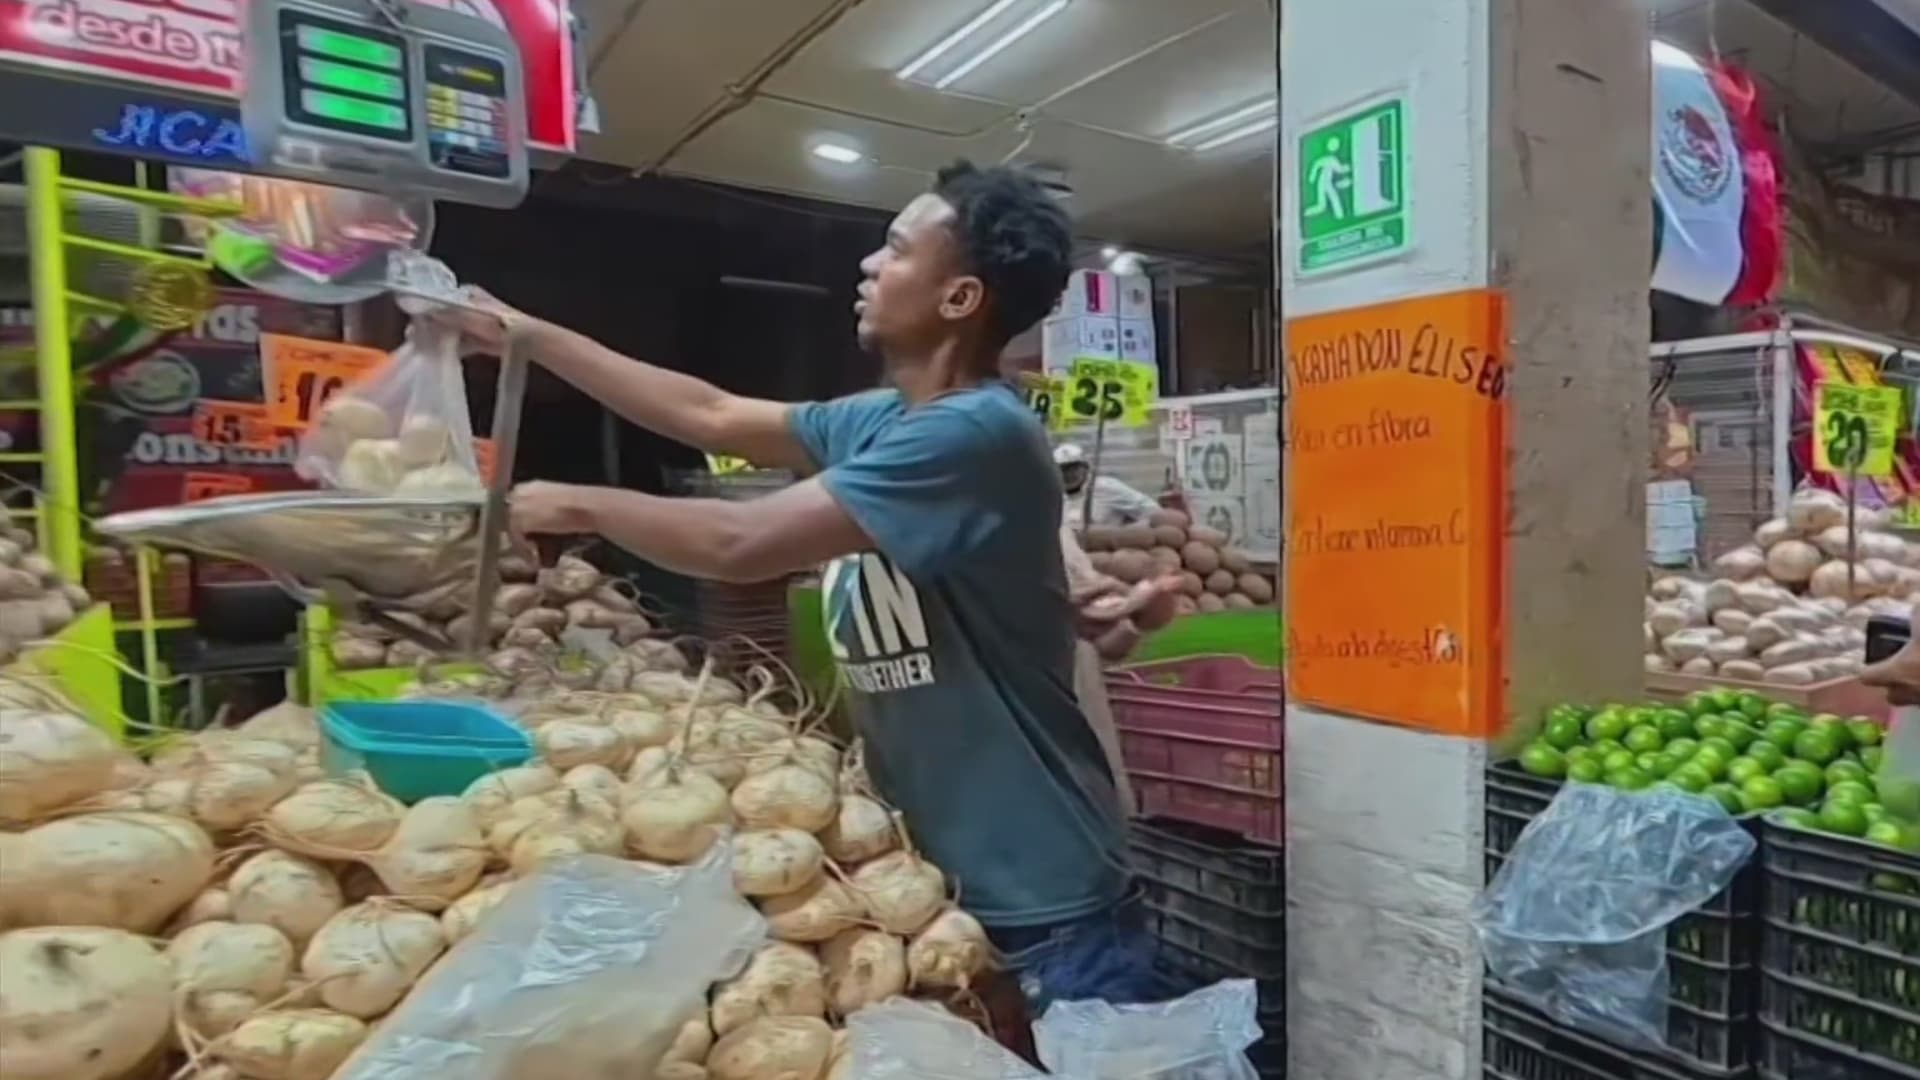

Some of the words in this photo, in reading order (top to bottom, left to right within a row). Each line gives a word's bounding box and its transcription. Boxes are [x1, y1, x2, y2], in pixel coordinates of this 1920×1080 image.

[32, 0, 198, 61] desde
[1356, 328, 1401, 374] DON
[1072, 377, 1123, 419] 25
[205, 413, 241, 443] 15
[1366, 407, 1432, 445] fibra
[1827, 410, 1867, 469] 20
